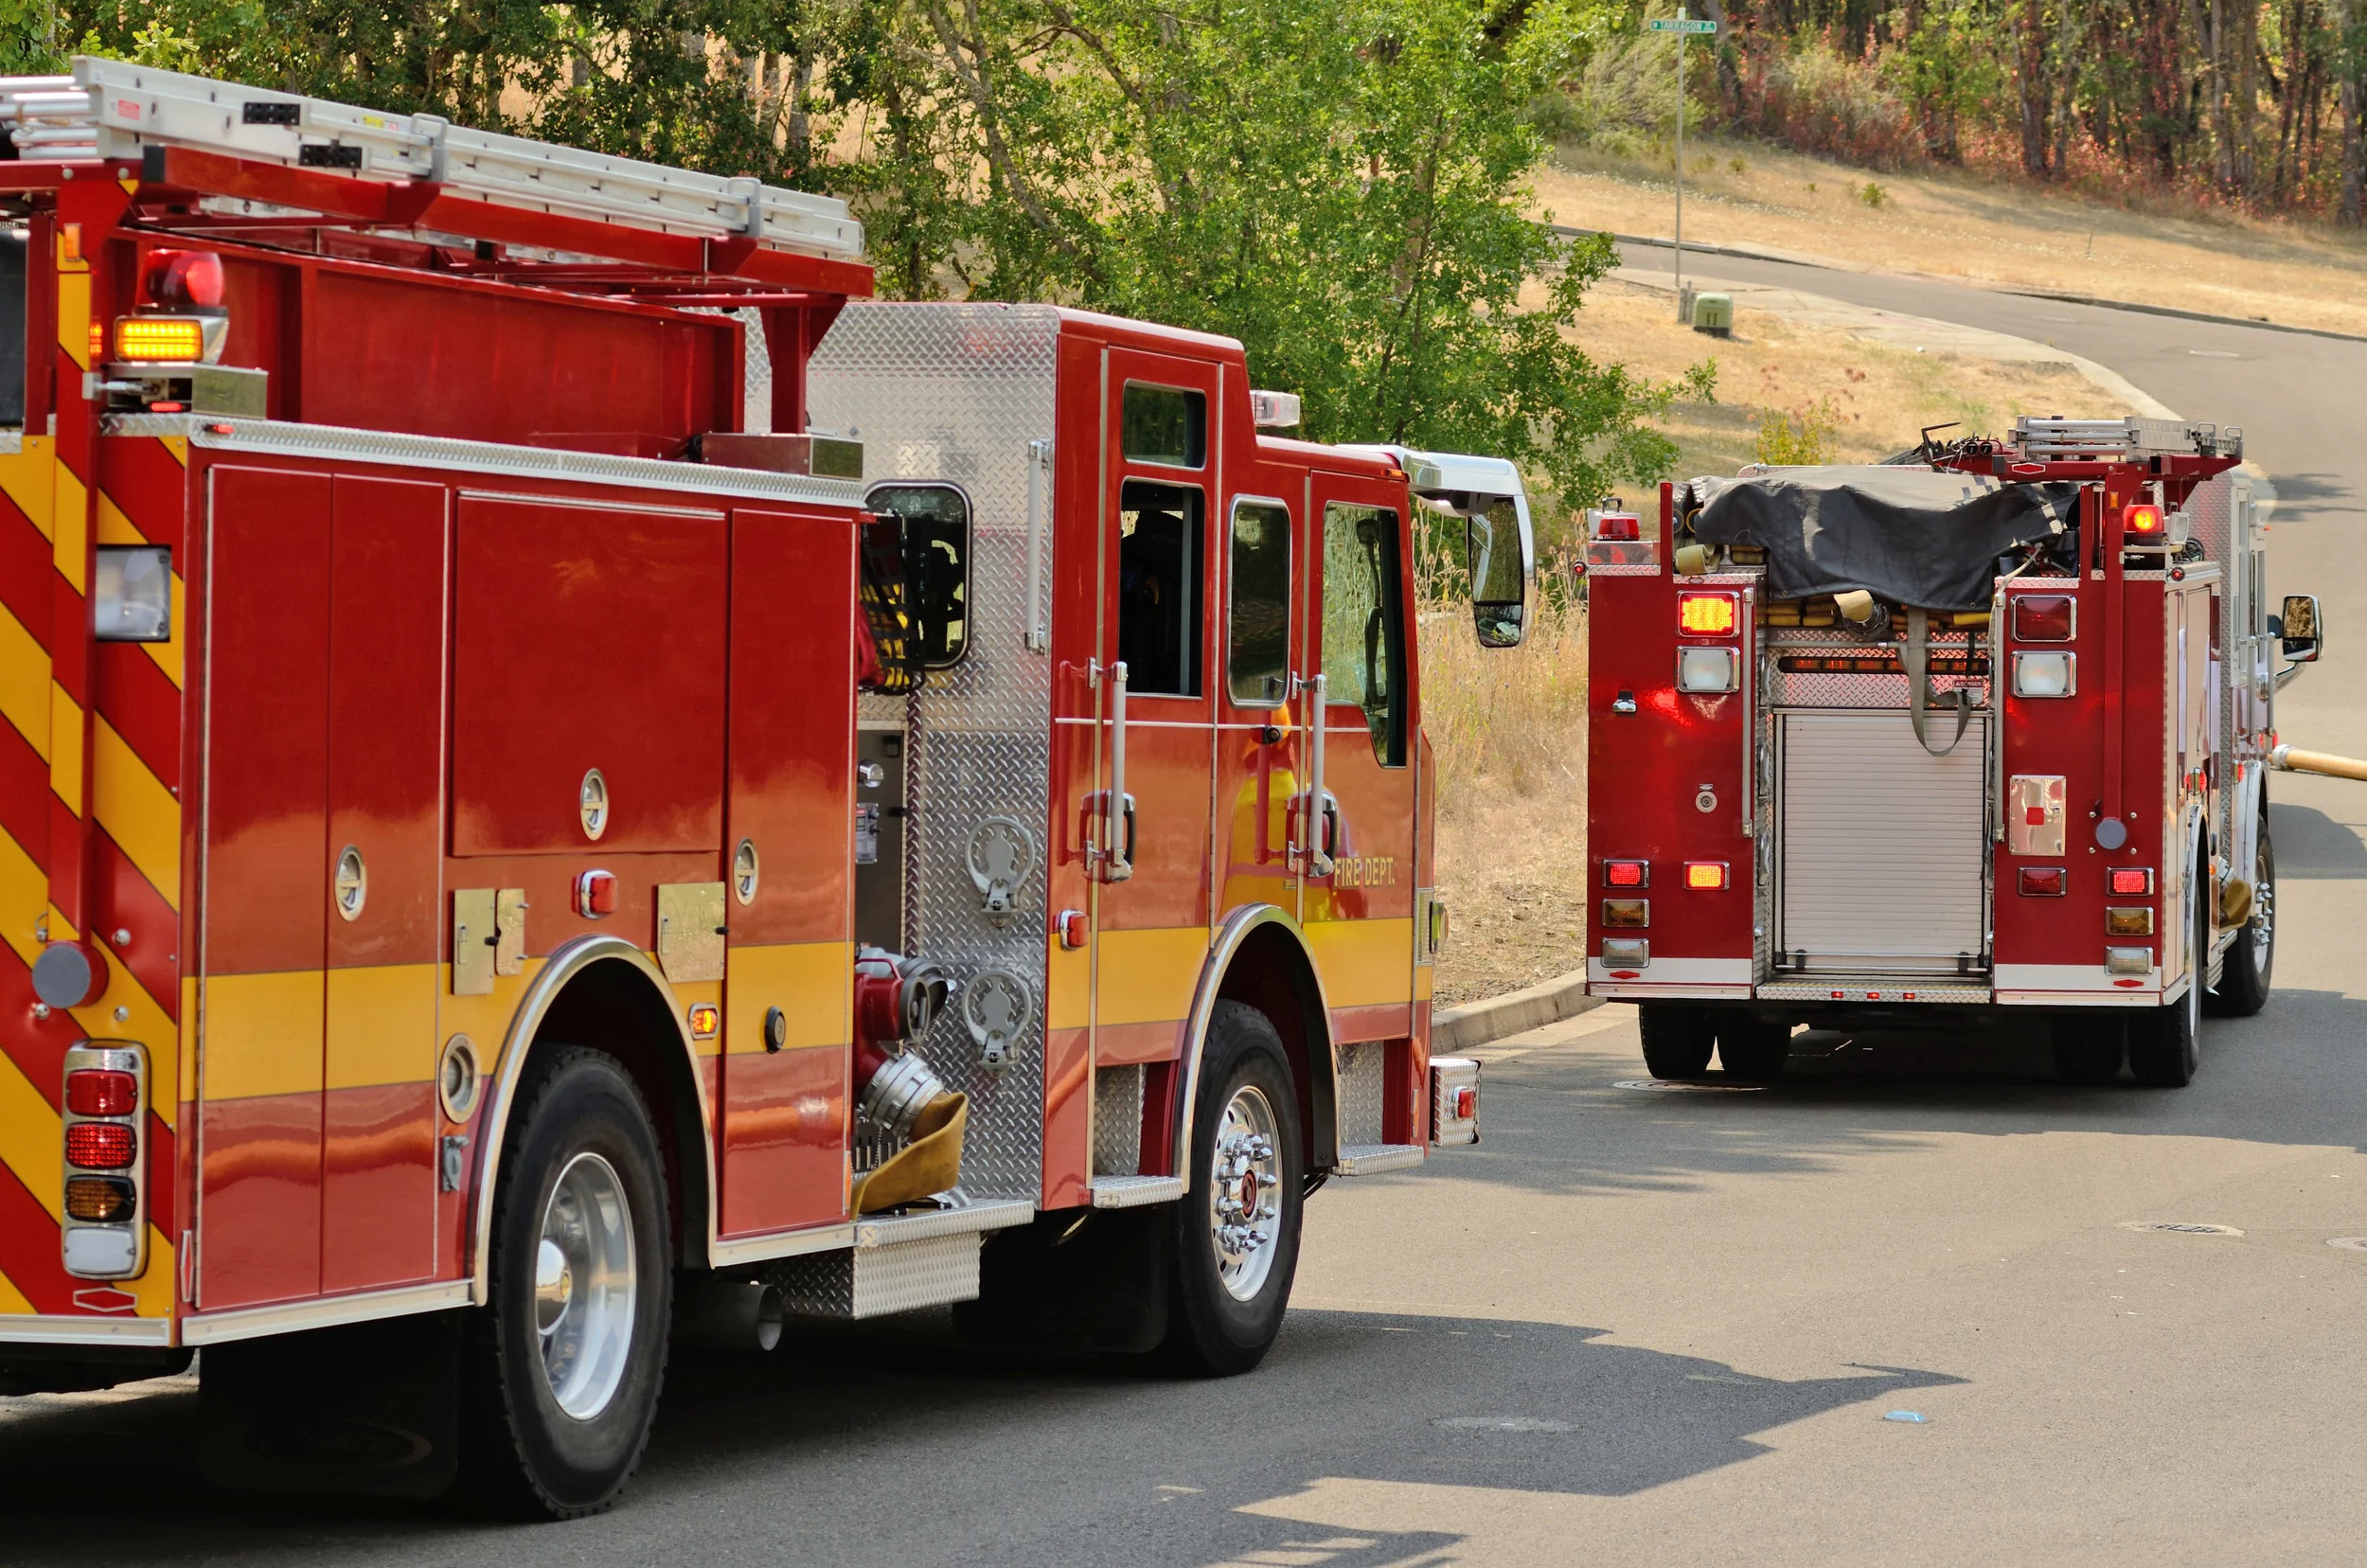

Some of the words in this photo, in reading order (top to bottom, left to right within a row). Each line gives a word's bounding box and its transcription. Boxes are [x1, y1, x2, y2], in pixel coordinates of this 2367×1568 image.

[1661, 21, 1701, 31] TARRAGON
[1334, 858, 1361, 887] FIRE
[1364, 857, 1396, 886] DEPT.
